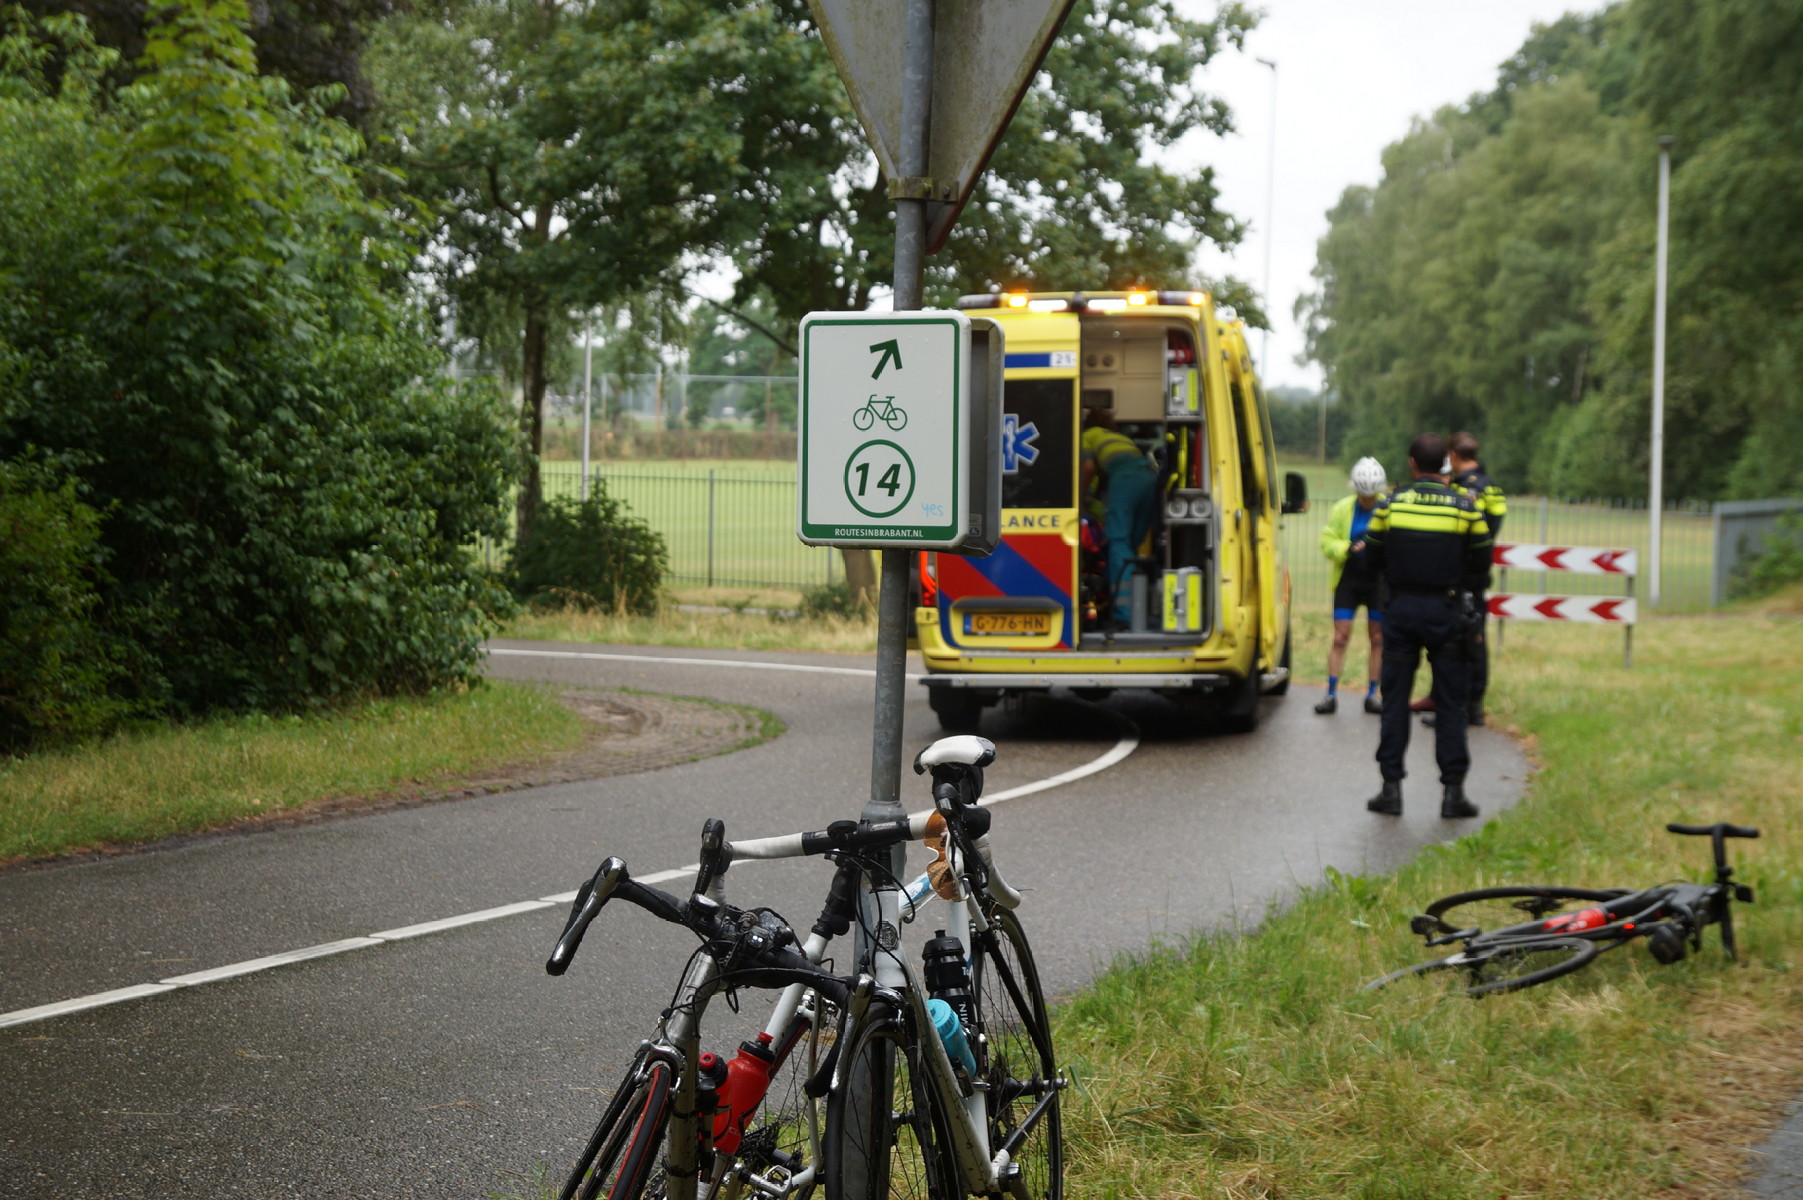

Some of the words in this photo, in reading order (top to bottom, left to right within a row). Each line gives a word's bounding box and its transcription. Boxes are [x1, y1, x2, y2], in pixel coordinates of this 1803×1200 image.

[855, 463, 901, 497] 14
[921, 502, 945, 518] yes
[1001, 514, 1061, 527] ANCE
[834, 528, 924, 538] ROUTESINBRABANT.NL
[975, 615, 1045, 630] G-776-HN
